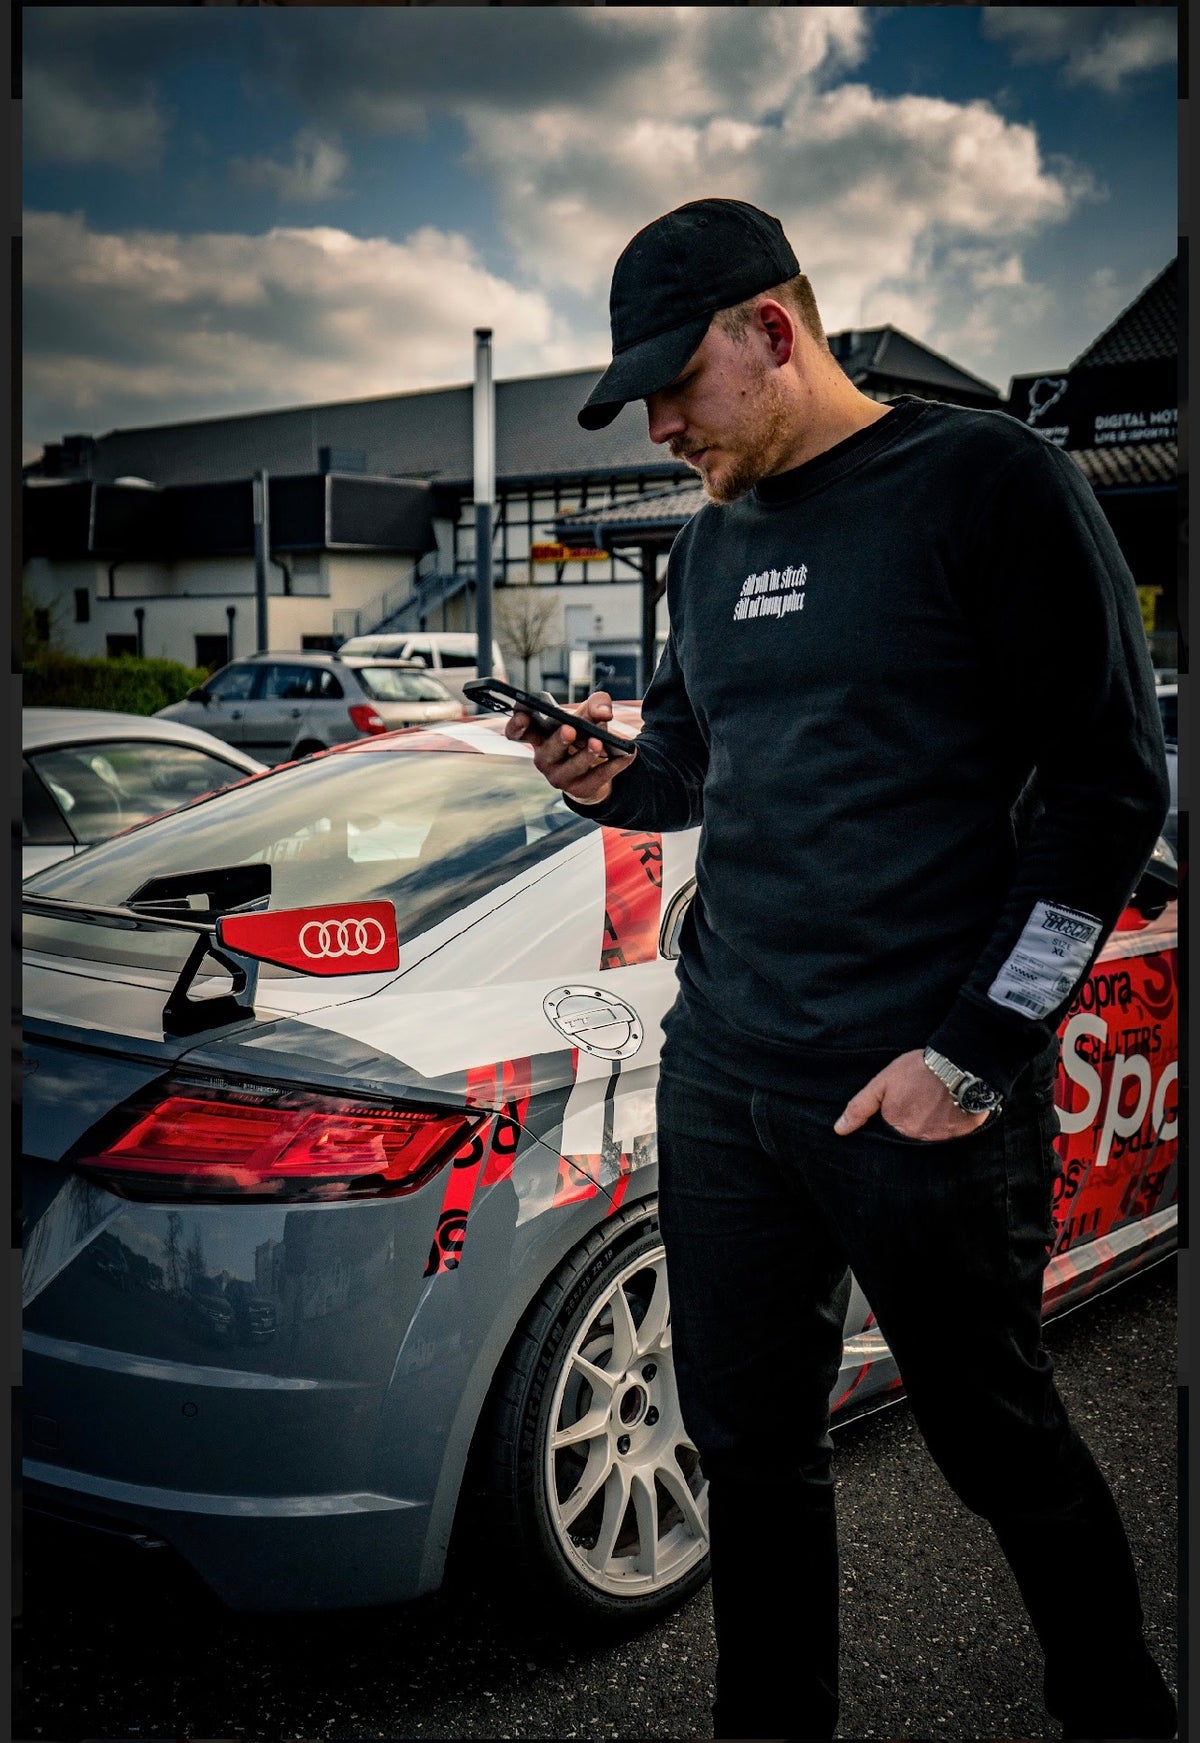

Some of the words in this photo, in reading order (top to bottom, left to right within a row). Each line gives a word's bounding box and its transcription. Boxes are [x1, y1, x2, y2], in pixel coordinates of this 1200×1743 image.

[1095, 411, 1146, 430] DIGITAL
[1095, 430, 1116, 444] LIVE
[769, 568, 781, 591] the
[780, 563, 808, 589] streets
[1051, 937, 1073, 951] SIZE
[1051, 946, 1065, 958] XL
[591, 1260, 604, 1277] ZR
